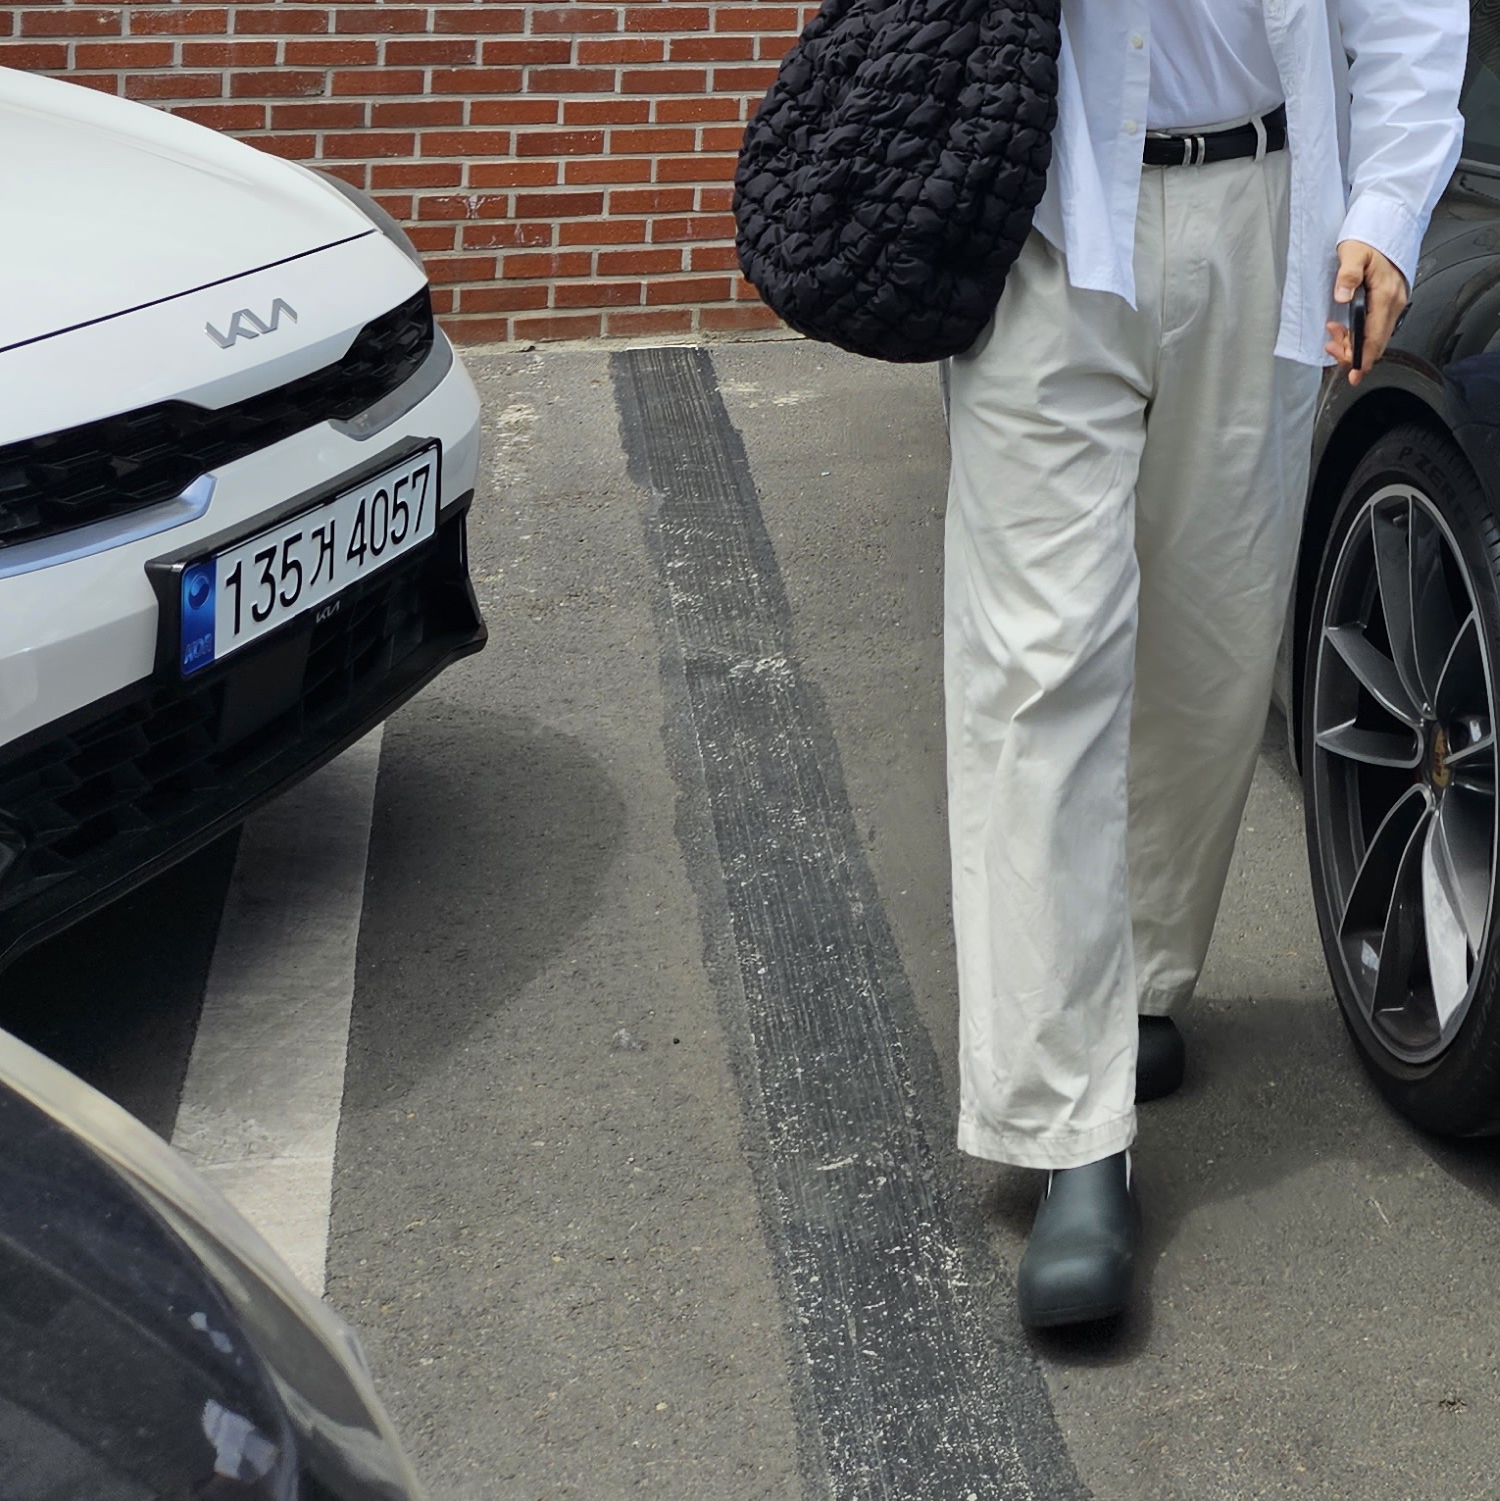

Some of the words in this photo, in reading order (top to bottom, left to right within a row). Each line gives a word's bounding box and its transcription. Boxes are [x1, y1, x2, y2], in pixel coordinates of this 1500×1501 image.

[205, 298, 298, 349] KIA
[225, 518, 335, 636] 135거
[346, 463, 430, 567] 4057
[316, 600, 340, 624] KIA
